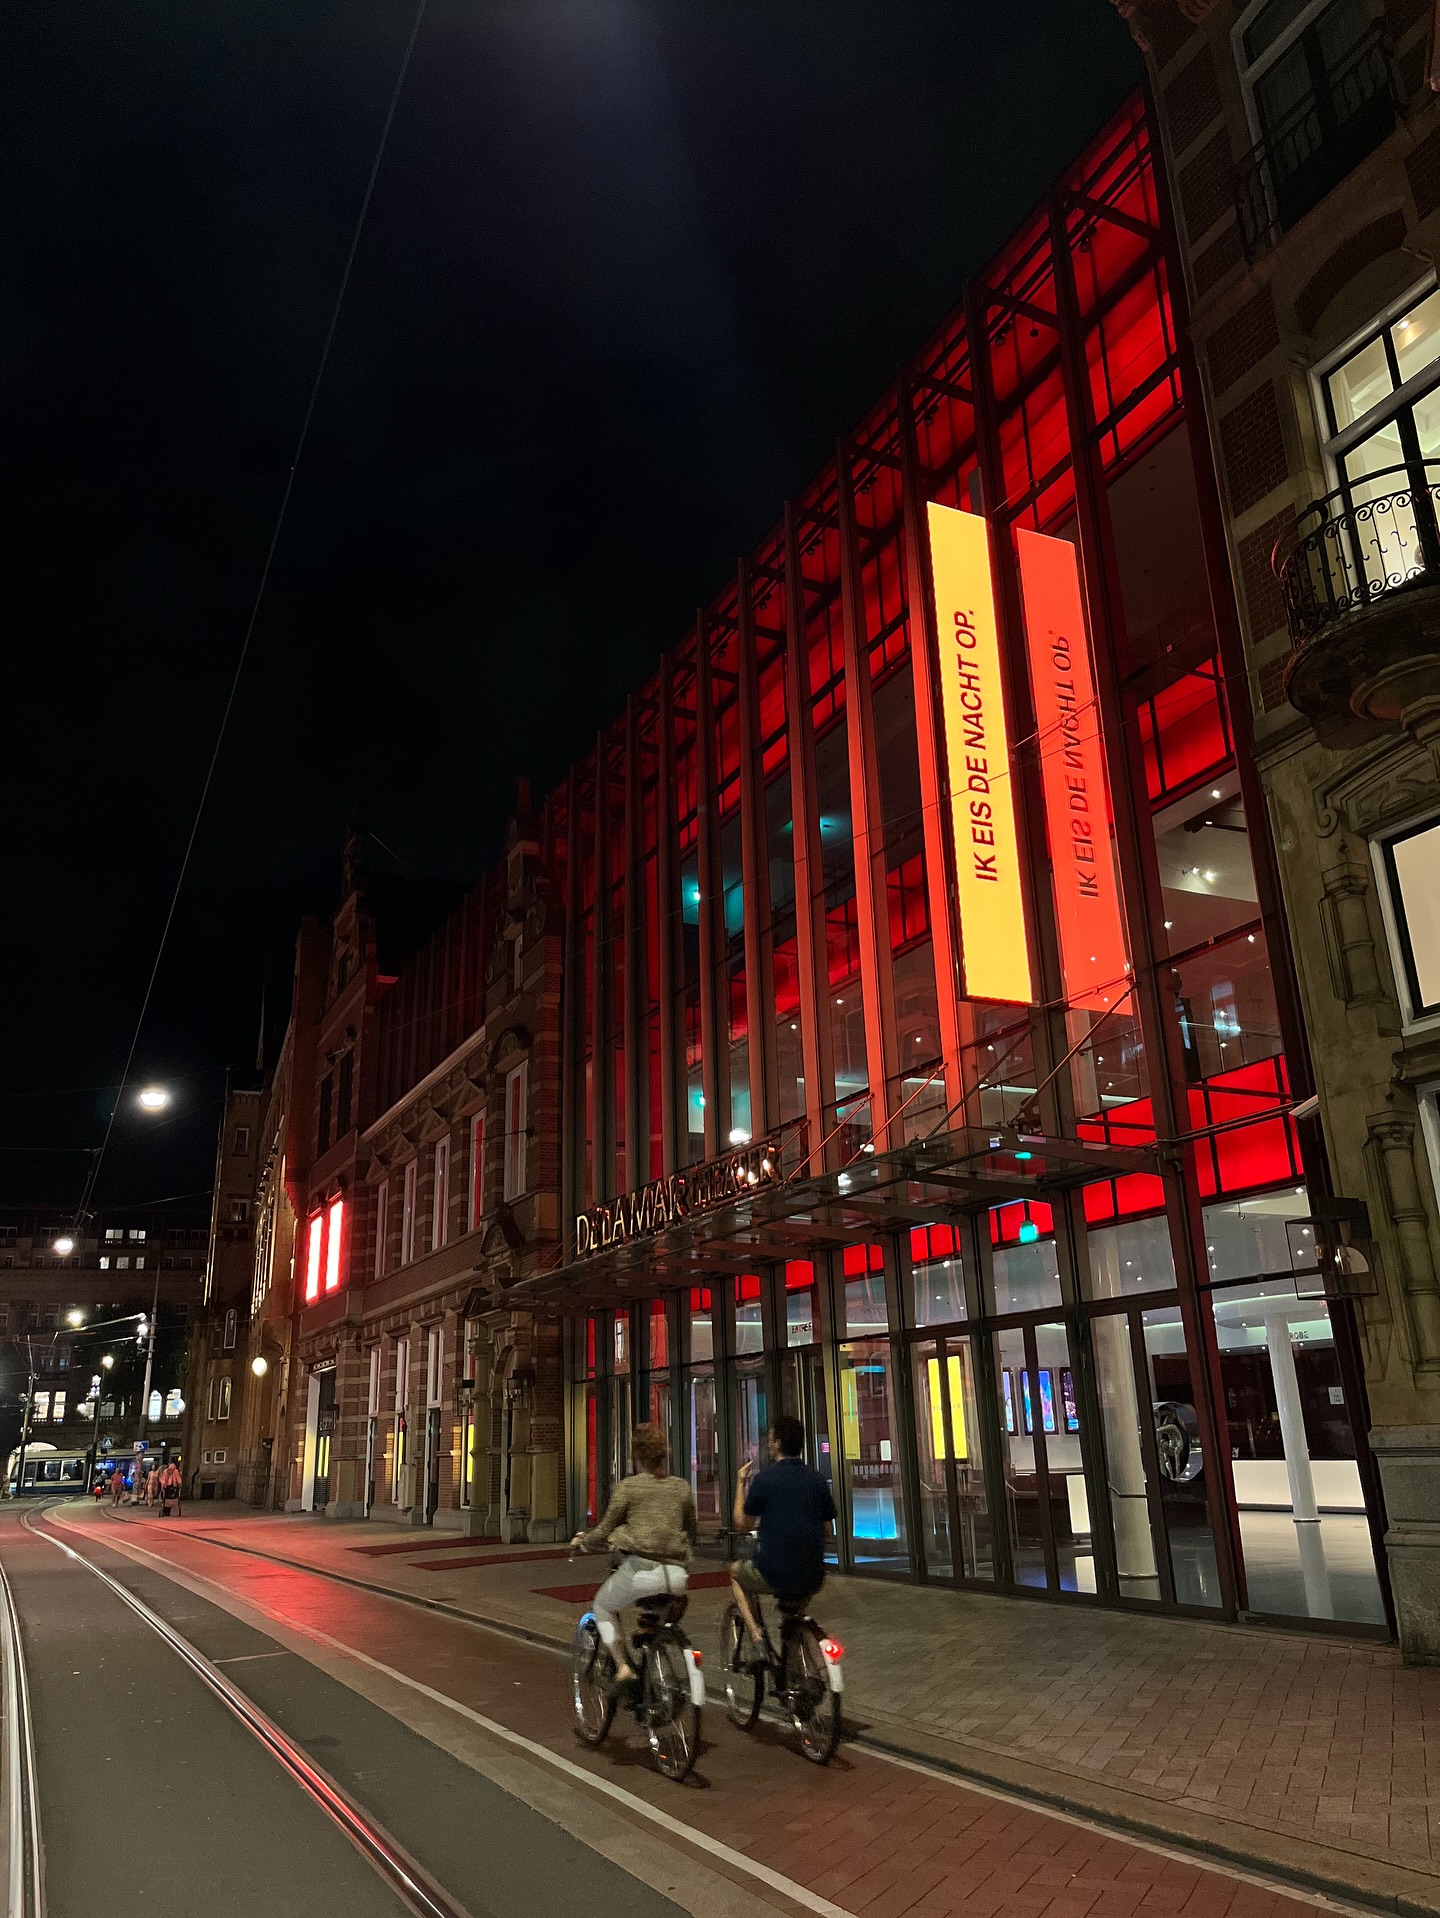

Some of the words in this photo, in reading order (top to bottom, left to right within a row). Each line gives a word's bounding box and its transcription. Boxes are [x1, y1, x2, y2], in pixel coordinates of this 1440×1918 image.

[954, 610, 977, 649] OP.
[957, 653, 986, 750] NACHT
[966, 755, 990, 794] DE
[970, 801, 995, 846] EIS
[974, 852, 998, 882] IK
